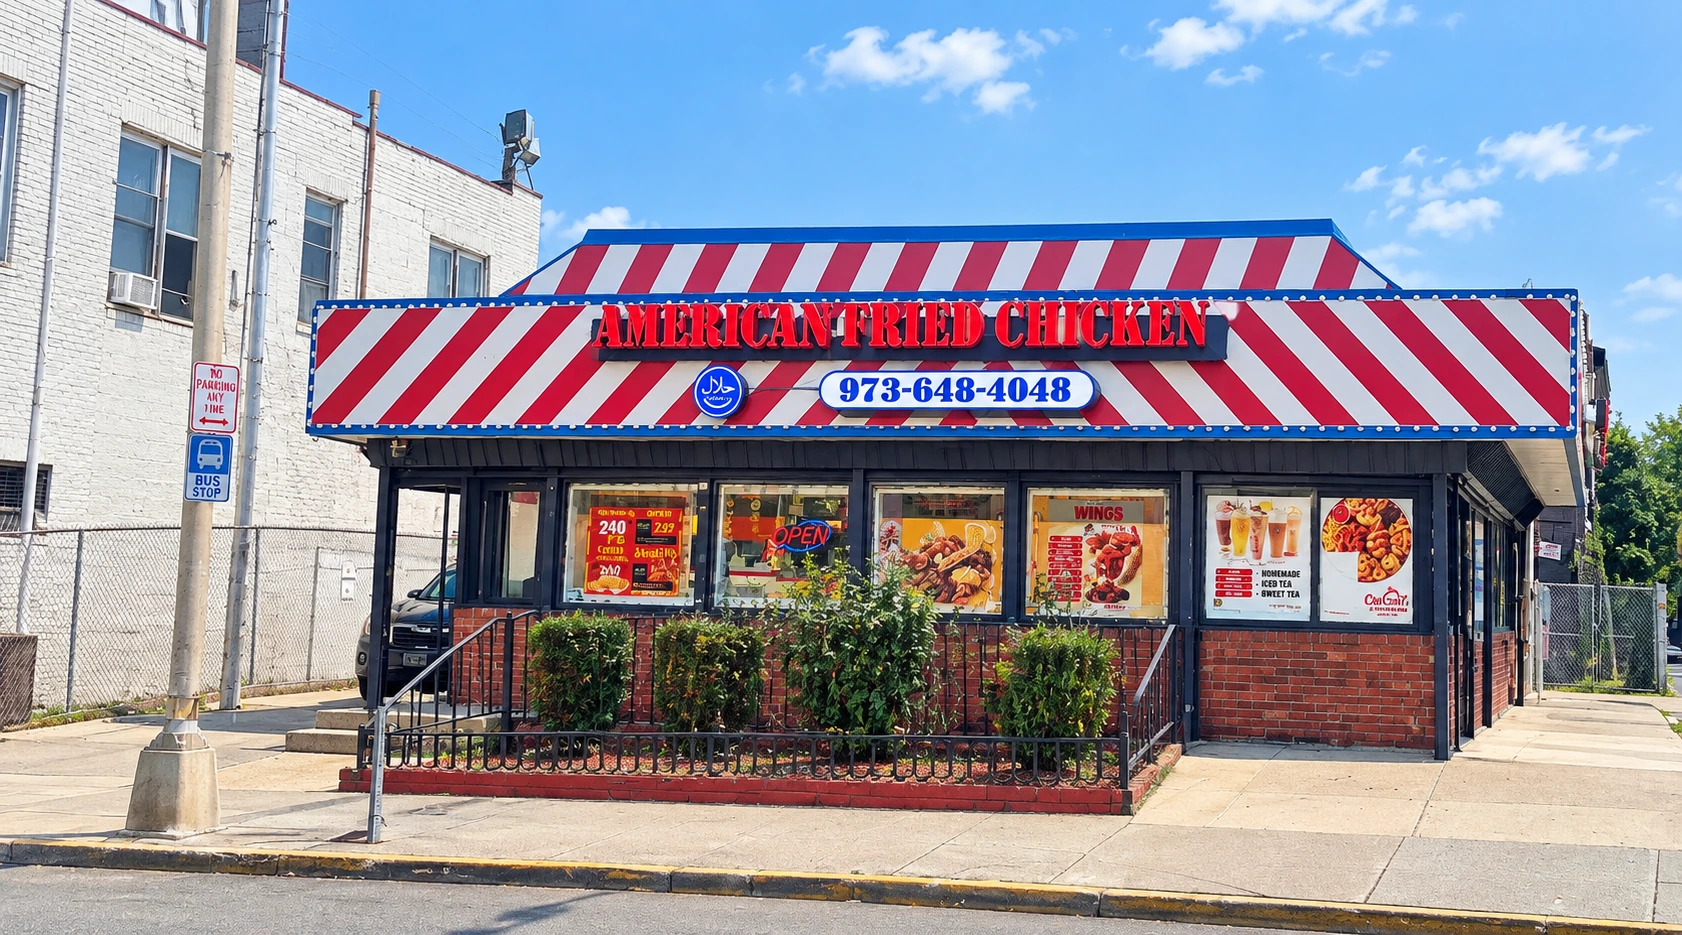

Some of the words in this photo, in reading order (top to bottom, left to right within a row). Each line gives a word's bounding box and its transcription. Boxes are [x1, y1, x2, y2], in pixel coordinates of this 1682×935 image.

[592, 302, 833, 349] AMERICAN
[841, 301, 986, 349] FRIED
[995, 300, 1211, 348] CHICKEN
[210, 368, 222, 379] NO
[196, 379, 236, 392] PARKING
[702, 375, 736, 395] حلال
[839, 377, 1071, 403] 973-648-4048
[206, 392, 224, 403] ANY
[195, 475, 220, 486] BUS
[192, 487, 221, 498] STOP
[1074, 505, 1124, 521] WINGS
[598, 520, 627, 535] 240
[771, 525, 829, 546] OPEN
[1279, 580, 1292, 588] TEA
[1261, 590, 1285, 598] SWEET
[1286, 590, 1300, 598] TEA
